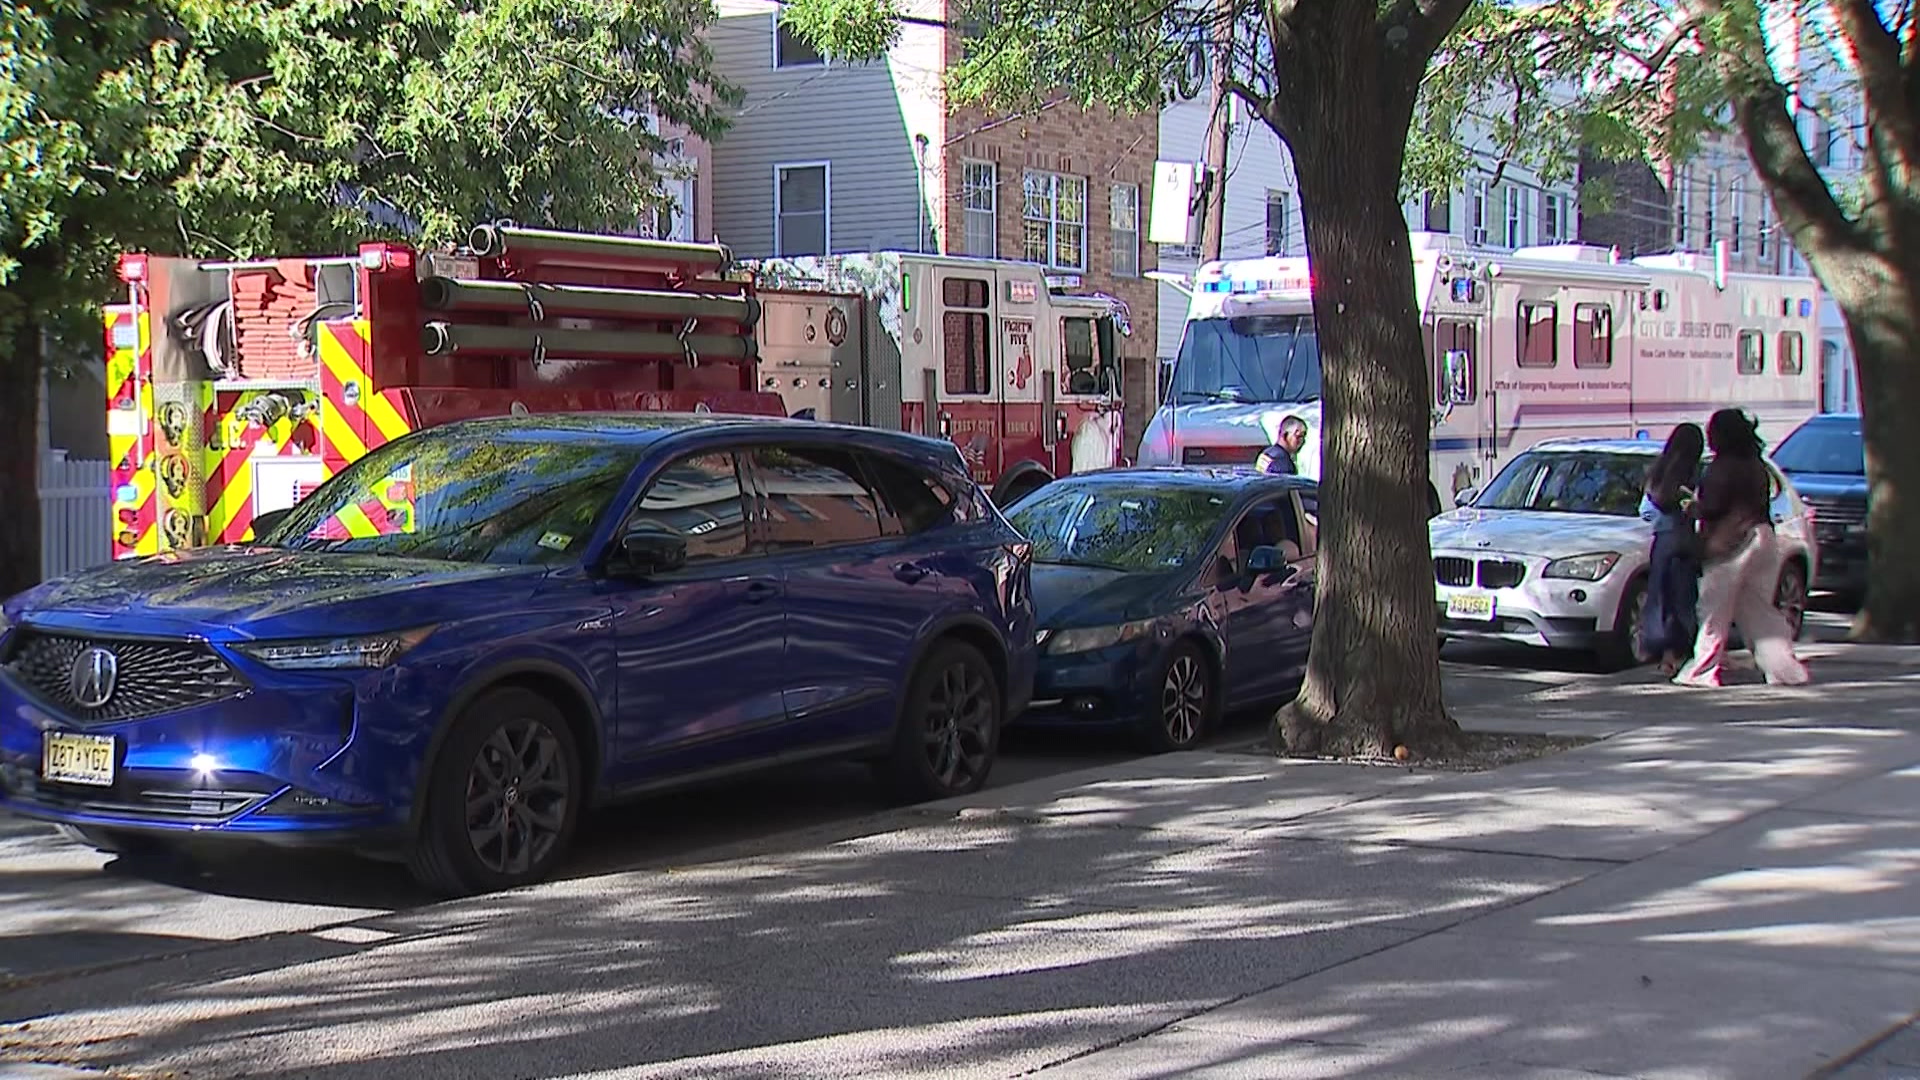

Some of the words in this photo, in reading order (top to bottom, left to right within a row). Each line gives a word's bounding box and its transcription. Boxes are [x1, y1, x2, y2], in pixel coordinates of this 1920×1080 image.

[1640, 321, 1660, 337] CITY
[1664, 321, 1677, 337] OF
[1679, 322, 1711, 338] JERSEY
[1714, 323, 1733, 339] CITY
